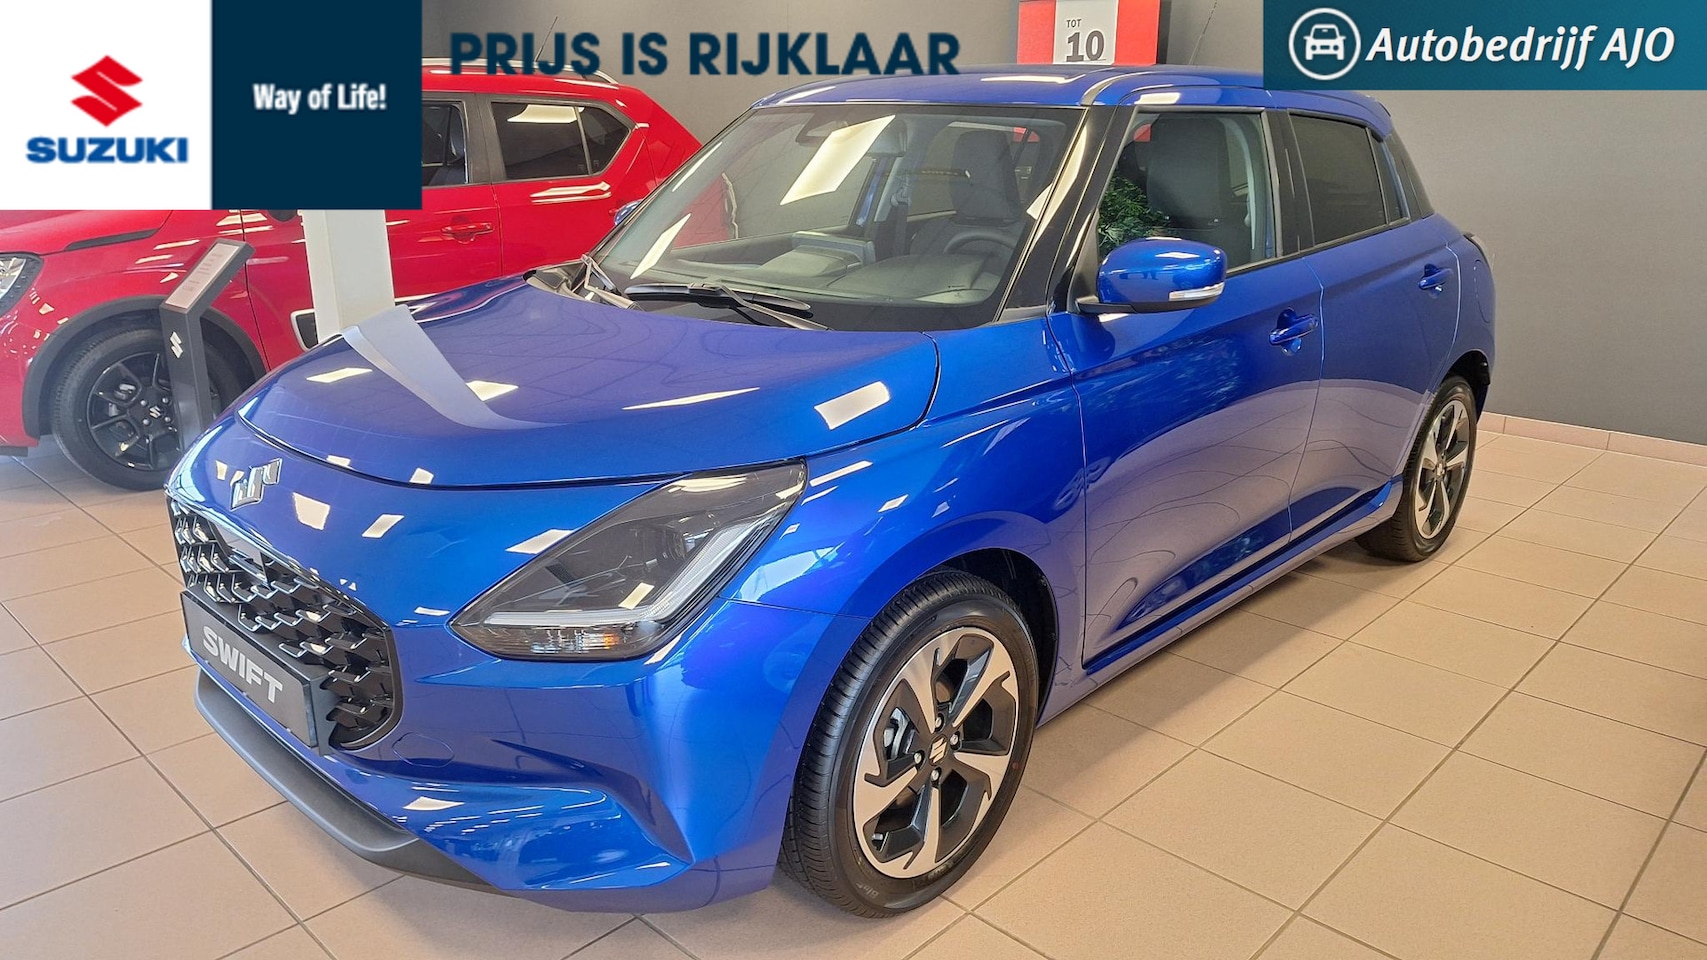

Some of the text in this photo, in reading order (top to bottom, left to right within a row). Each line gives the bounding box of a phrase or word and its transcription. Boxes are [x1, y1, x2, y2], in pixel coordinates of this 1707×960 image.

[1066, 18, 1082, 28] TOT
[1066, 30, 1105, 62] 10
[203, 625, 283, 703] SWIFT
